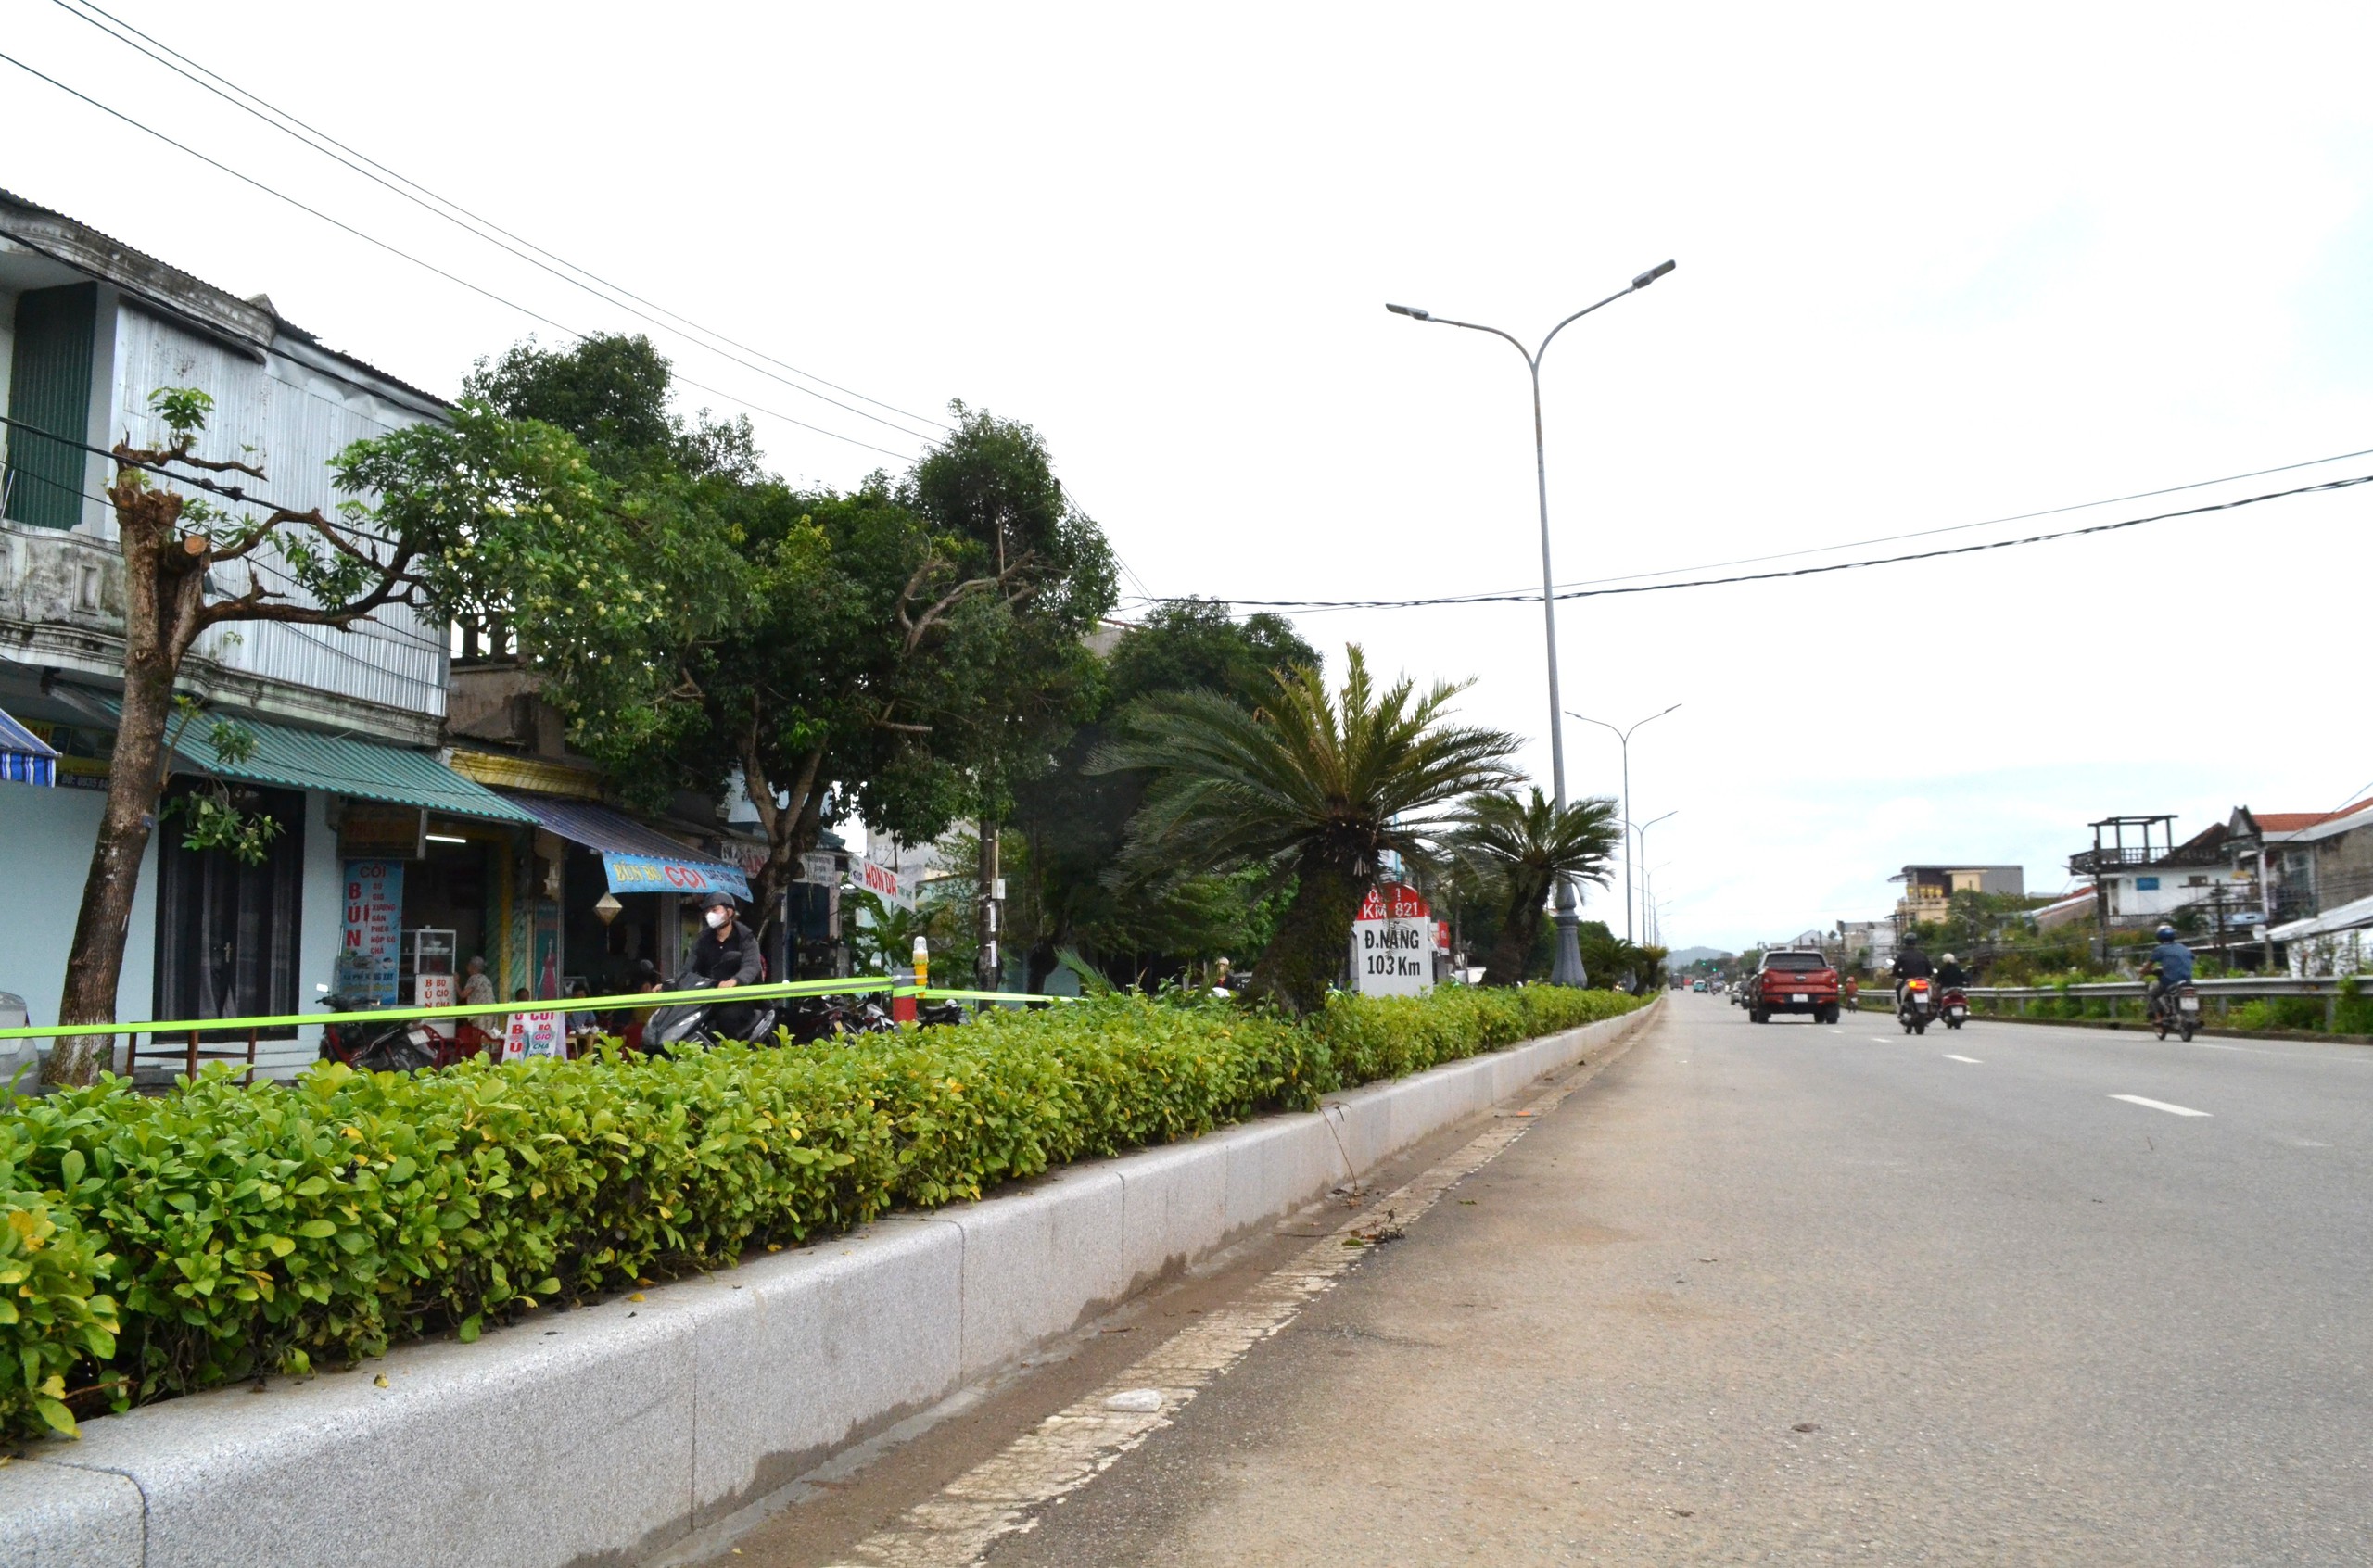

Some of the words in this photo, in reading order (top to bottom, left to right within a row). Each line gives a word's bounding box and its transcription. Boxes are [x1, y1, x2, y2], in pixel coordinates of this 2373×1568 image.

[613, 860, 642, 882] BÚN
[1364, 904, 1387, 918] KM
[1395, 902, 1418, 917] 821
[1367, 955, 1395, 975] 103
[1398, 956, 1420, 976] Km
